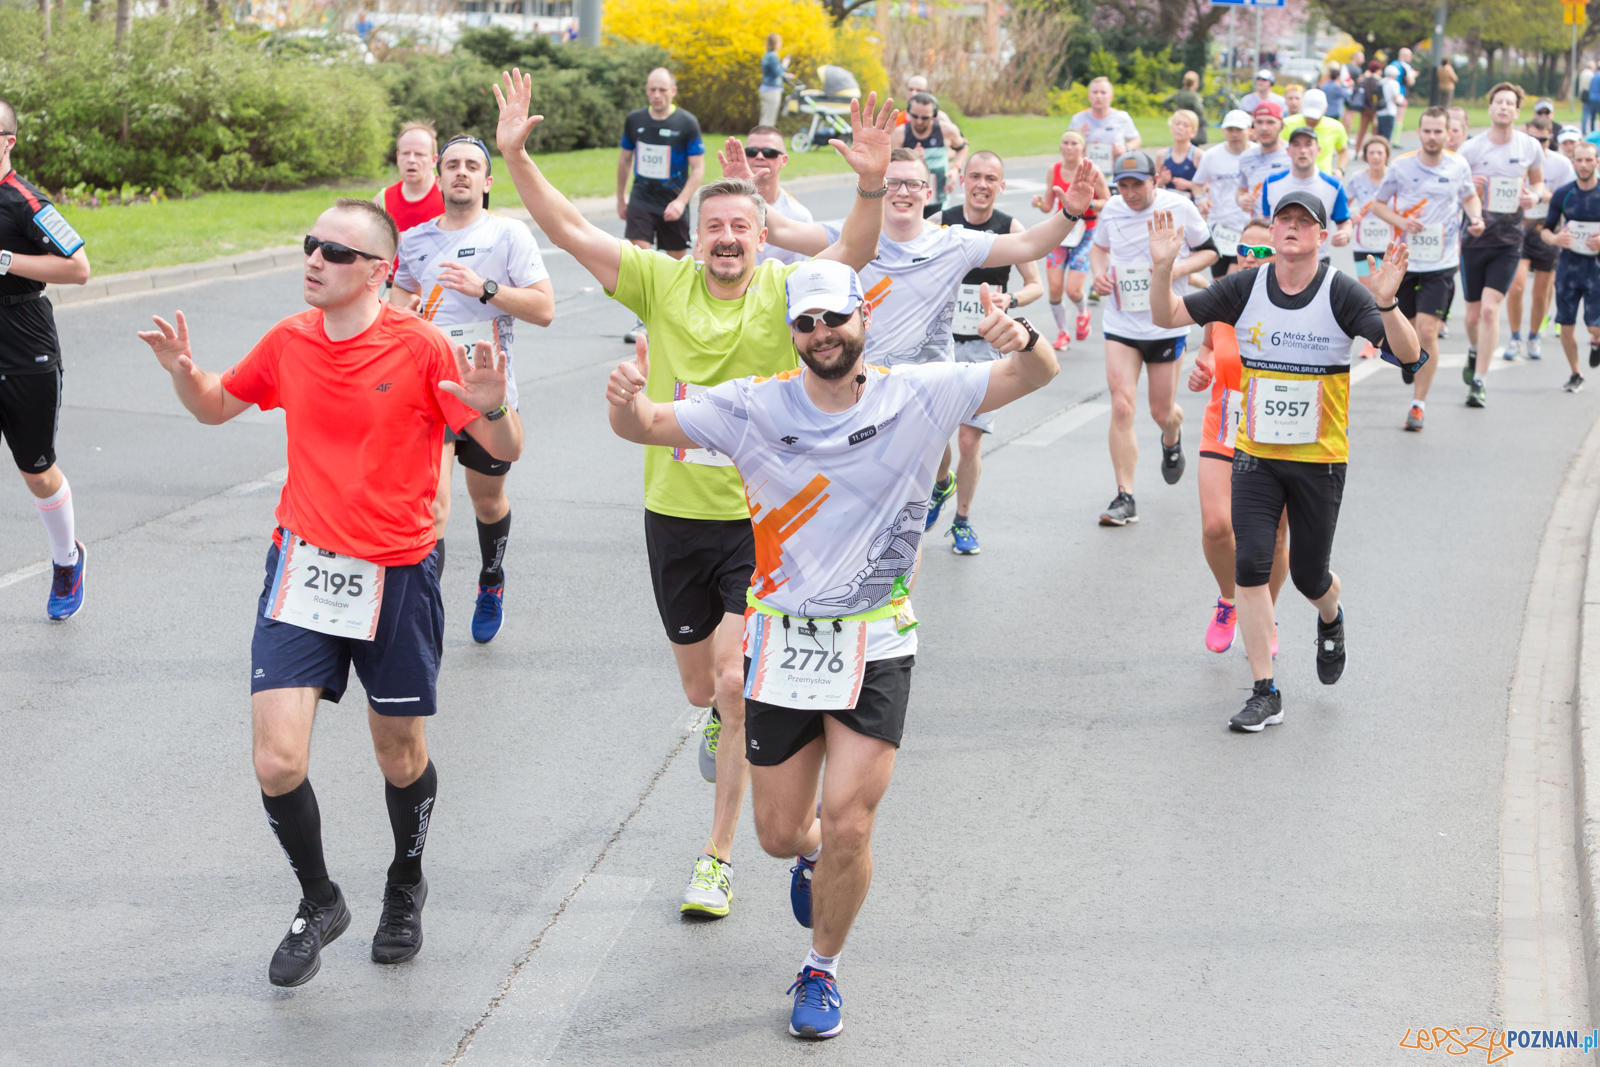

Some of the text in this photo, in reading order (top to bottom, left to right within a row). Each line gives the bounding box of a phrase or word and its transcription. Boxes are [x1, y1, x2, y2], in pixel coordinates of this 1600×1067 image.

[1495, 188, 1518, 198] 7107
[1411, 235, 1440, 246] 5305
[1271, 331, 1330, 347] 6 Mróz Śrem
[1282, 340, 1329, 351] Półmaraton
[375, 382, 393, 392] 4F
[1264, 399, 1310, 417] 5957
[780, 435, 799, 445] 4F
[303, 565, 363, 597] 2195
[313, 595, 350, 609] Radosław
[780, 647, 844, 673] 2776
[787, 674, 832, 685] Przemysław
